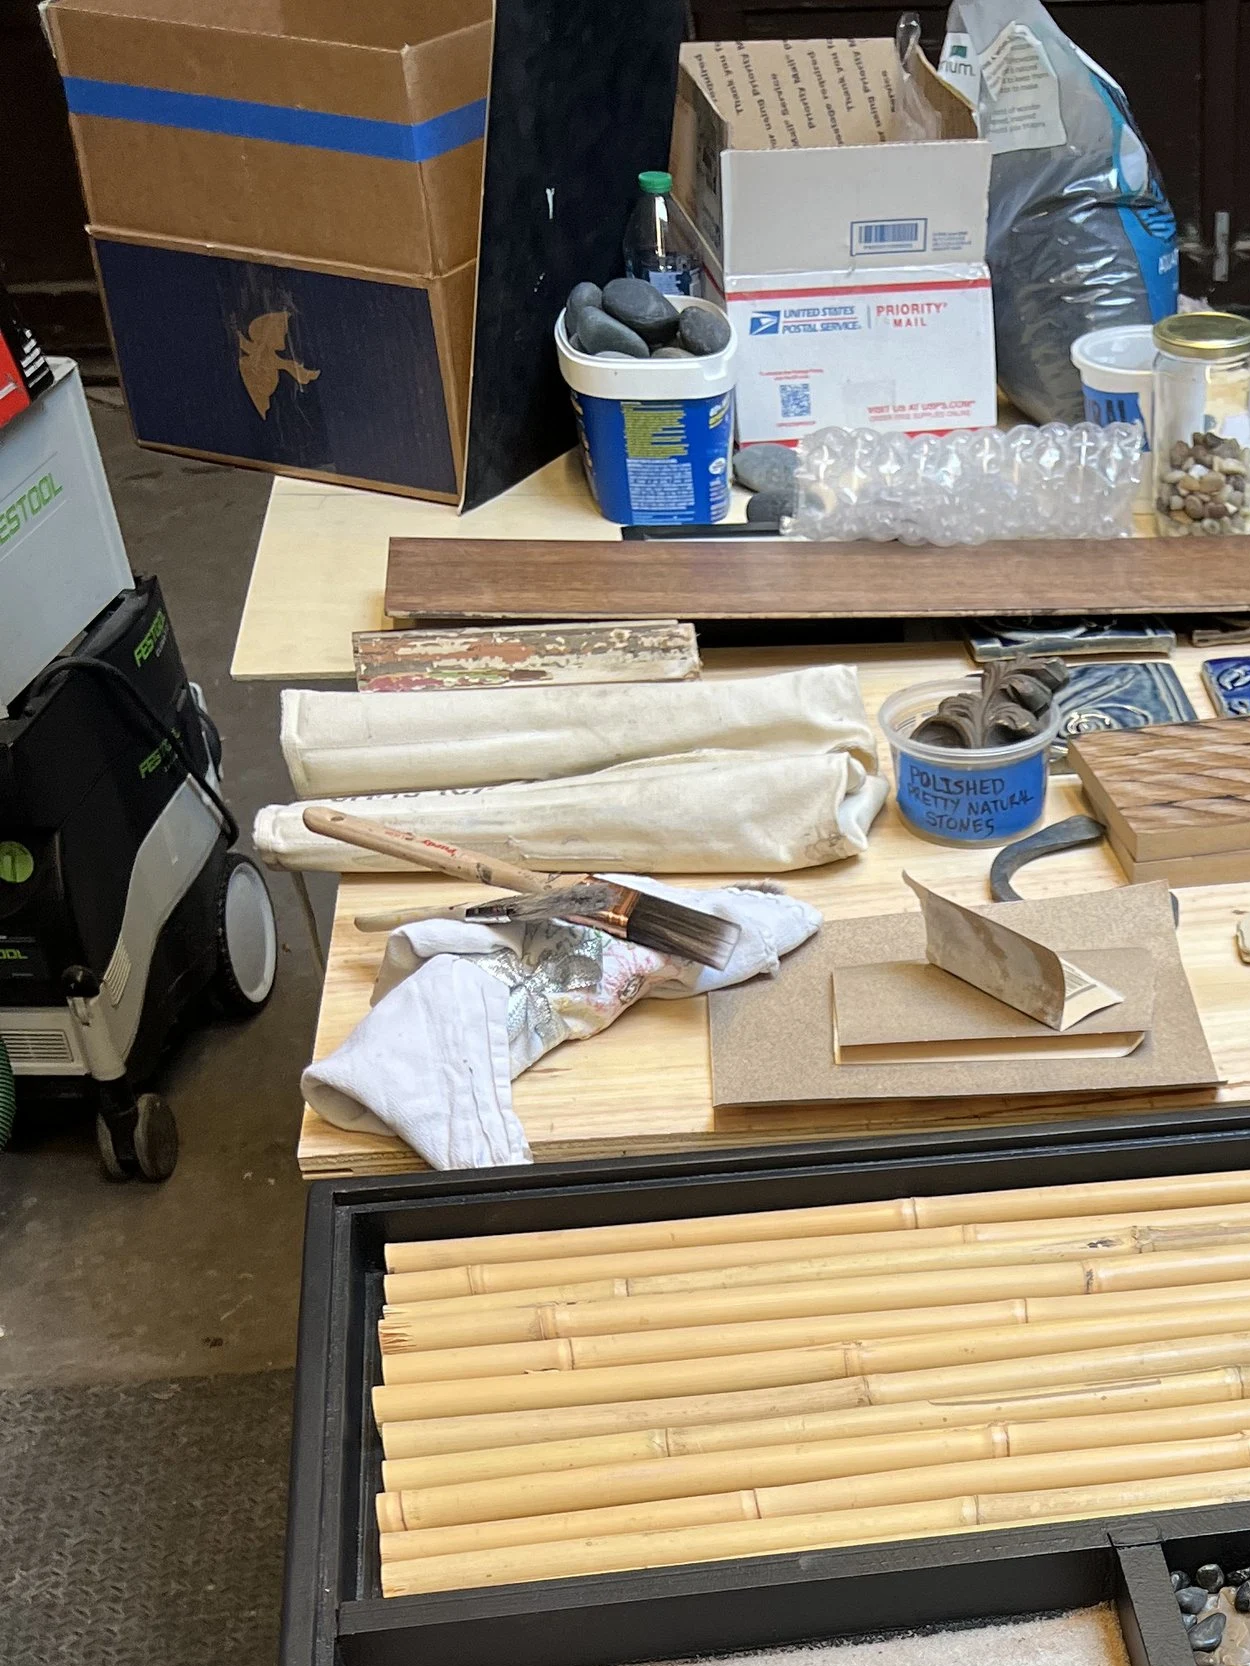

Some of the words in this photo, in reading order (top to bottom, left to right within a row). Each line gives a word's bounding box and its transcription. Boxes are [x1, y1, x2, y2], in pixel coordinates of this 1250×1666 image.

[741, 53, 761, 97] Priority
[797, 86, 816, 130] Priority
[783, 307, 820, 319] UNITED
[821, 305, 855, 317] STATES
[893, 318, 927, 328] MAIL
[782, 322, 818, 334] POSTAL
[909, 765, 1006, 797] POLISHED
[906, 782, 961, 815] PRETTY
[925, 811, 995, 841] STONES
